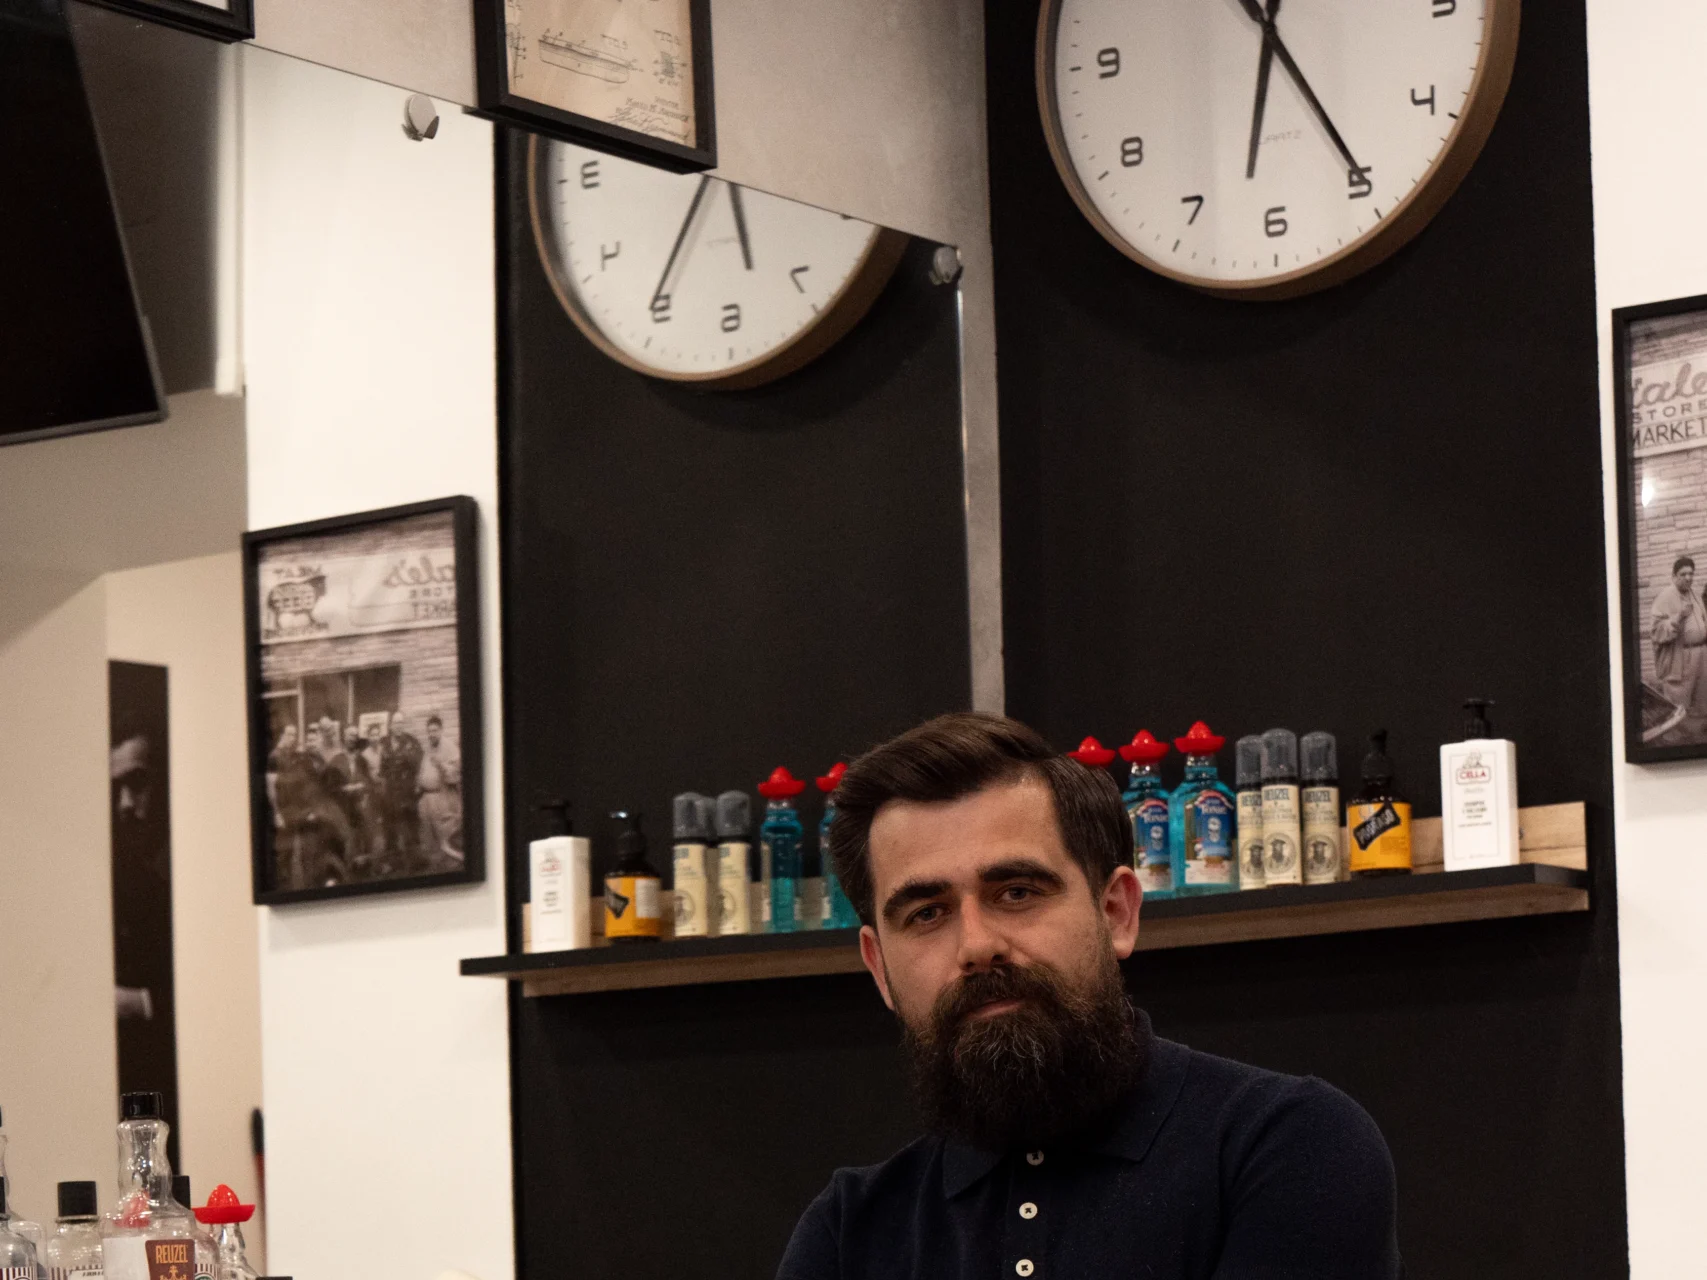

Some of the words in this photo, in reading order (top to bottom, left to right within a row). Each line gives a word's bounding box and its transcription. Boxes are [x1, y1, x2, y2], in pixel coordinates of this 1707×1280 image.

[1097, 47, 1120, 79] 9
[1410, 84, 1436, 115] 4
[1120, 136, 1144, 168] 8
[1348, 165, 1373, 199] 5
[1181, 194, 1205, 226] 7
[1264, 206, 1288, 238] 6
[155, 1244, 189, 1264] REUZEL
